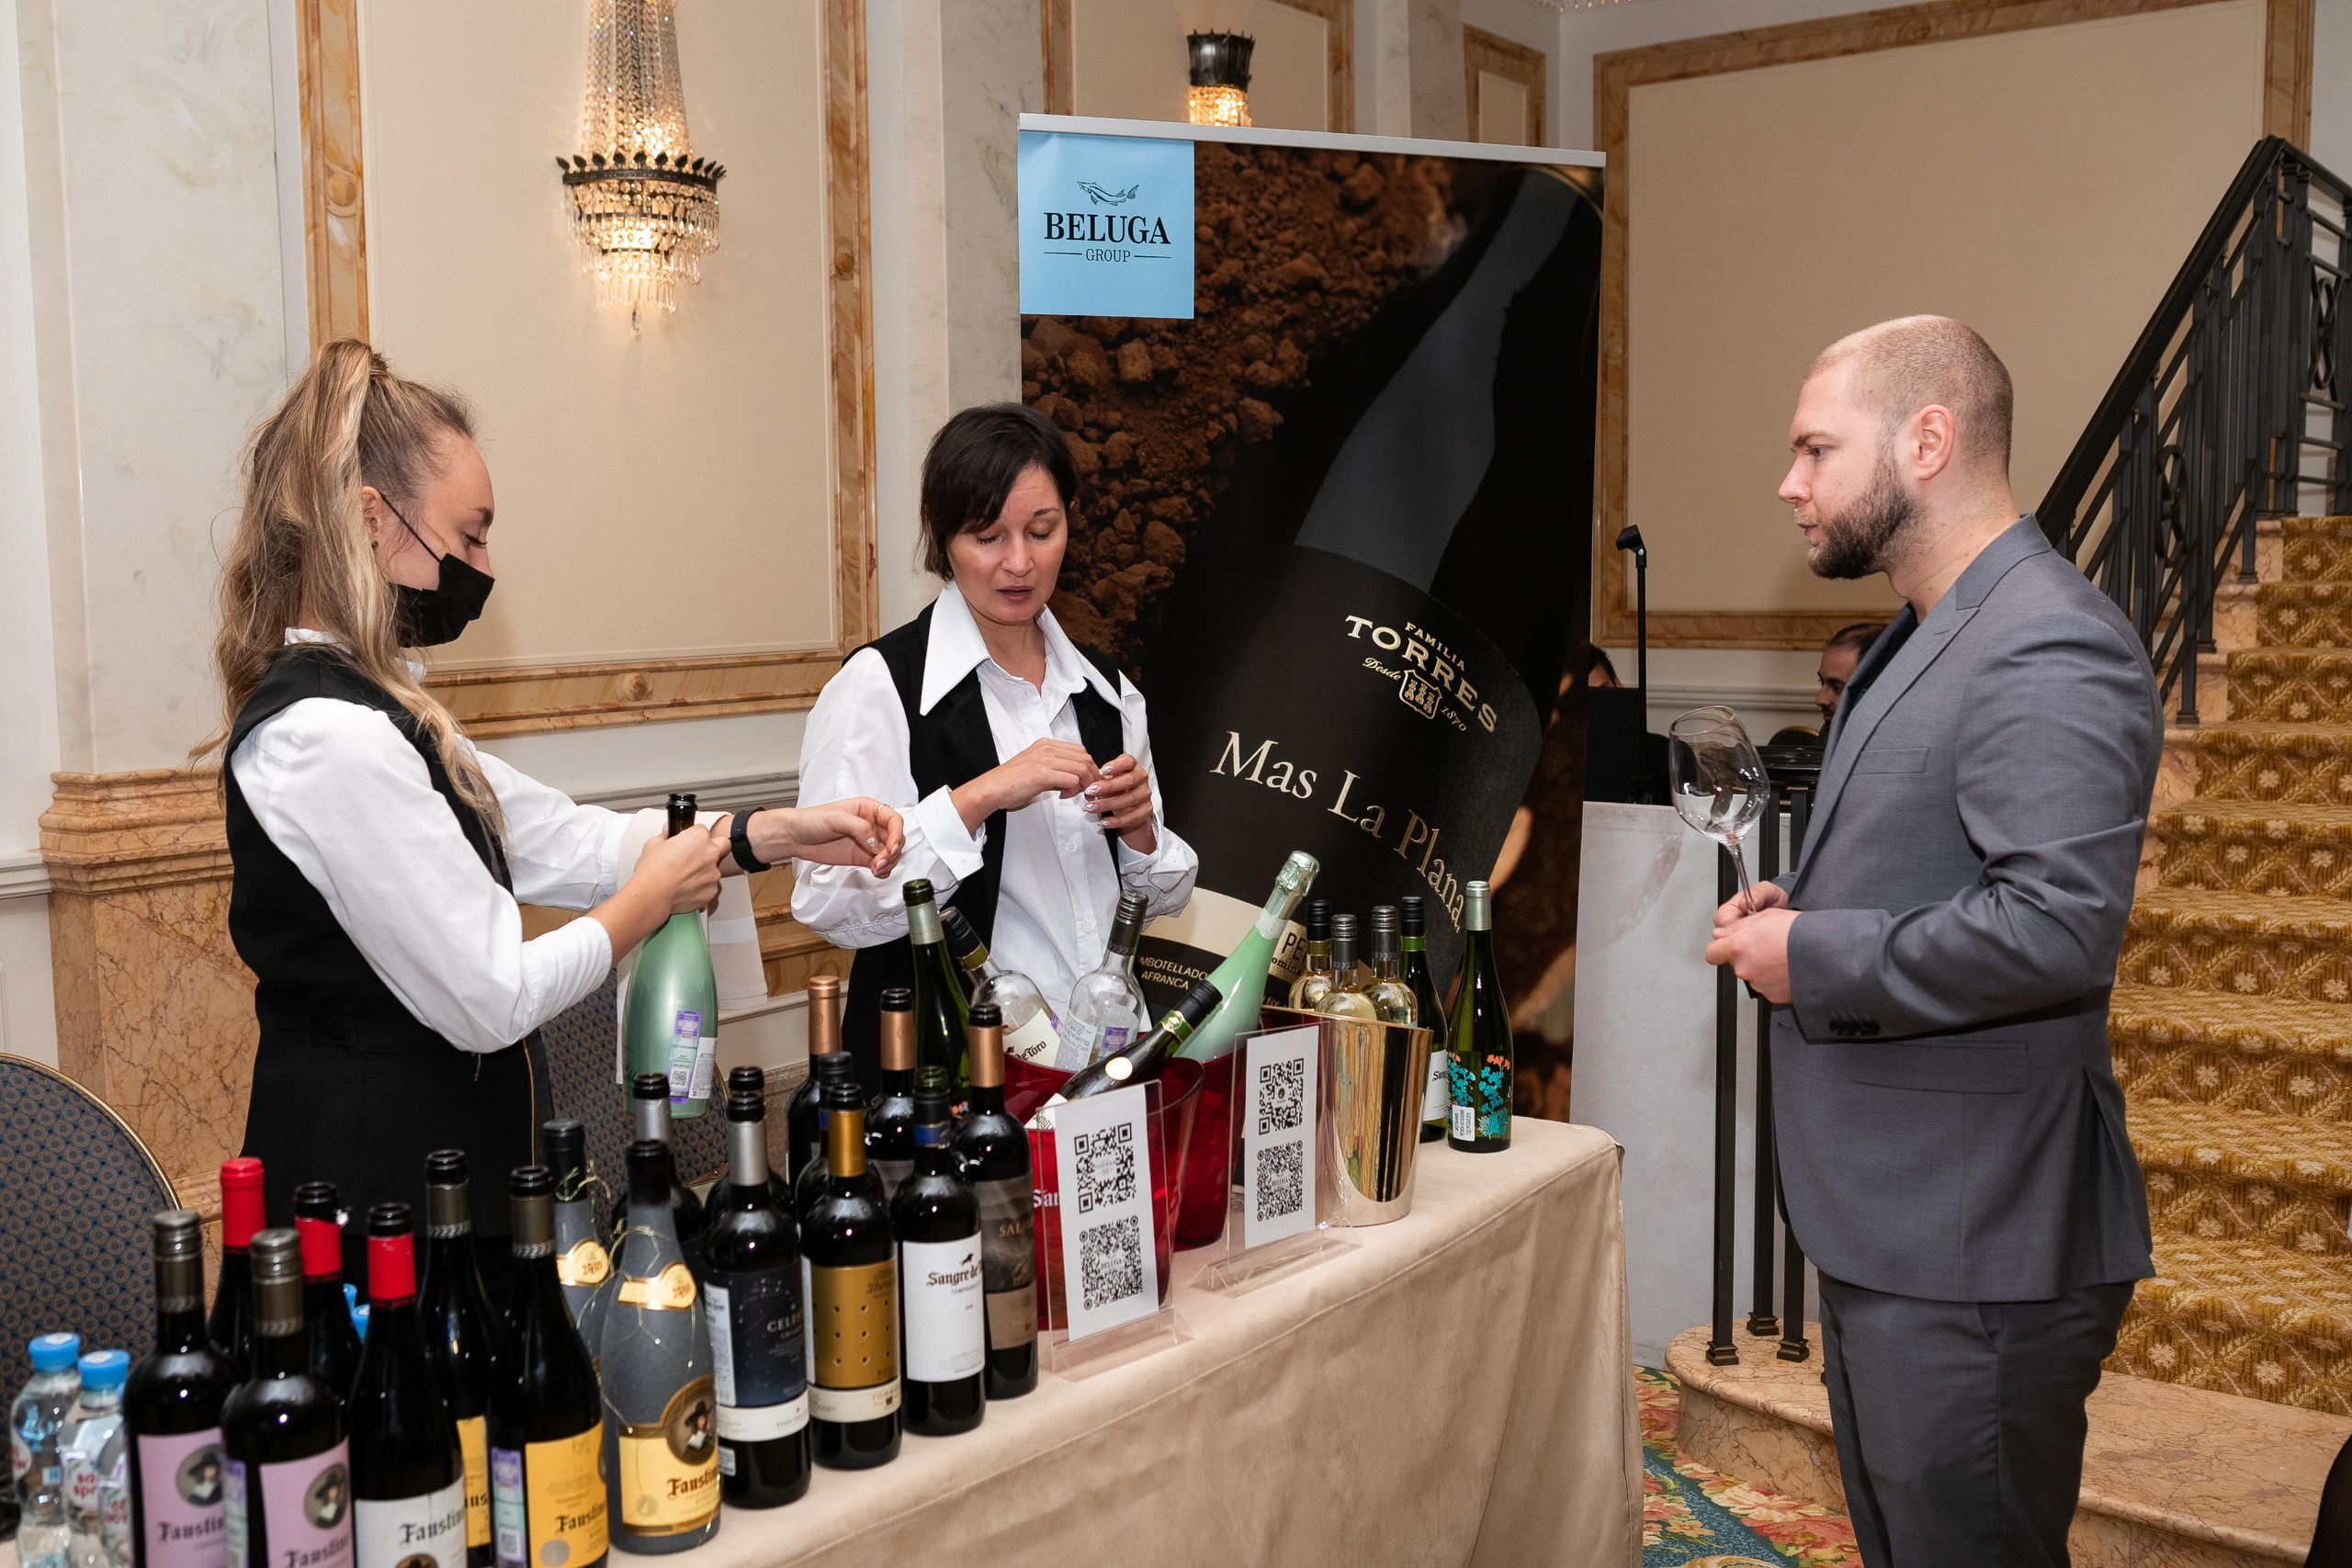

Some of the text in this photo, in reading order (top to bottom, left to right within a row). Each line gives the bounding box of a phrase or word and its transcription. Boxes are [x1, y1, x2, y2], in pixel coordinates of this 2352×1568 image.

[1043, 211, 1171, 245] BELUGA
[1085, 248, 1131, 263] GROUP
[1405, 621, 1465, 672] FAMILIA
[1344, 615, 1498, 733] TORRES
[1362, 657, 1467, 732] Desde 1870
[1209, 730, 1464, 934] Mas La Plana
[1136, 956, 1209, 981] MBOTELLADO
[1024, 1041, 1046, 1057] Toro
[926, 1270, 969, 1287] Sangre
